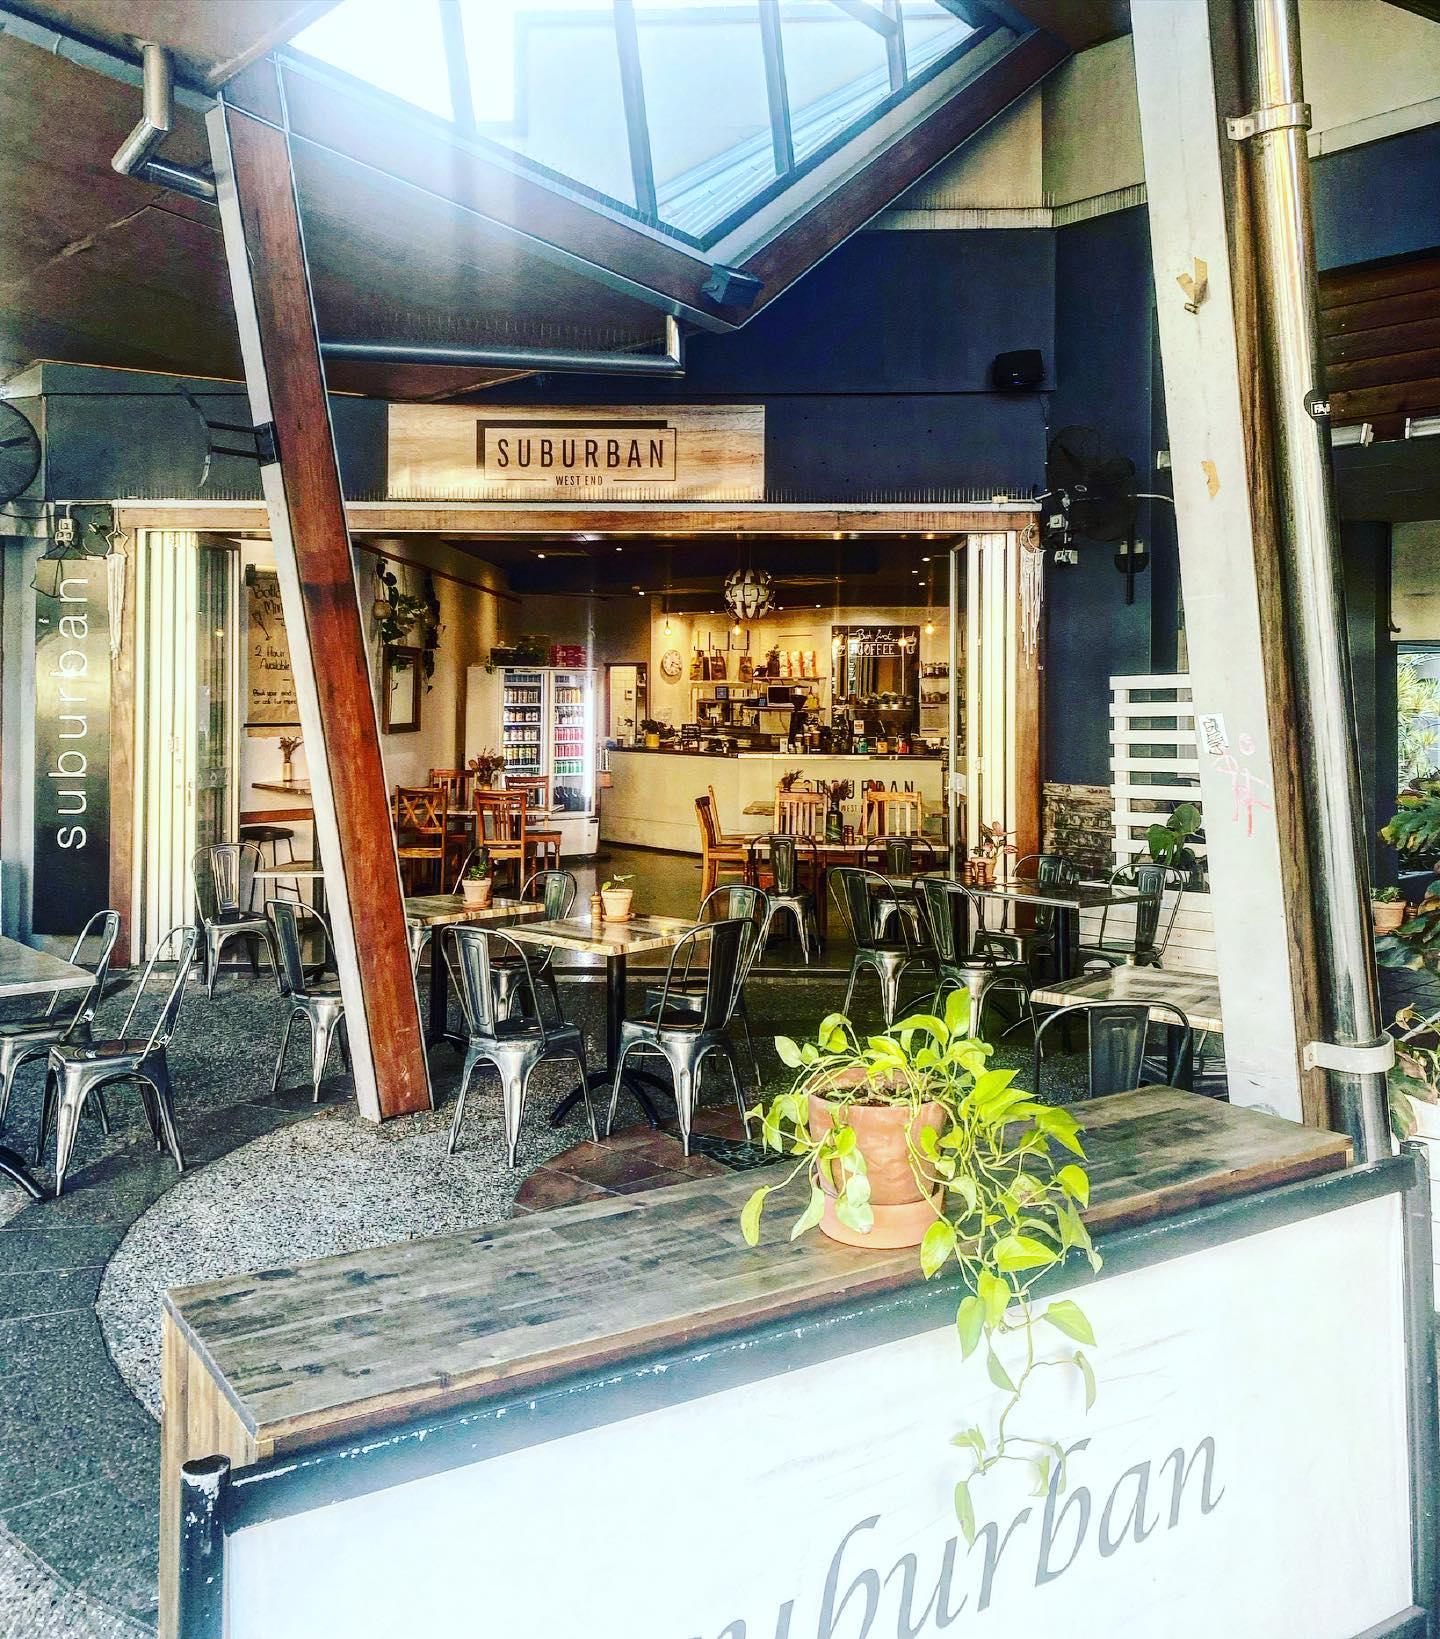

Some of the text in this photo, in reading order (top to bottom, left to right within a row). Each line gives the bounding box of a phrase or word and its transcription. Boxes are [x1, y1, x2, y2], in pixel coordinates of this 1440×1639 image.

[497, 438, 664, 468] SUBURBAN
[555, 475, 603, 486] WEST END
[856, 628, 872, 641] But
[254, 645, 262, 657] 2
[857, 643, 895, 655] COFFEE
[48, 577, 90, 849] suburban
[685, 1436, 1226, 1639] burban
